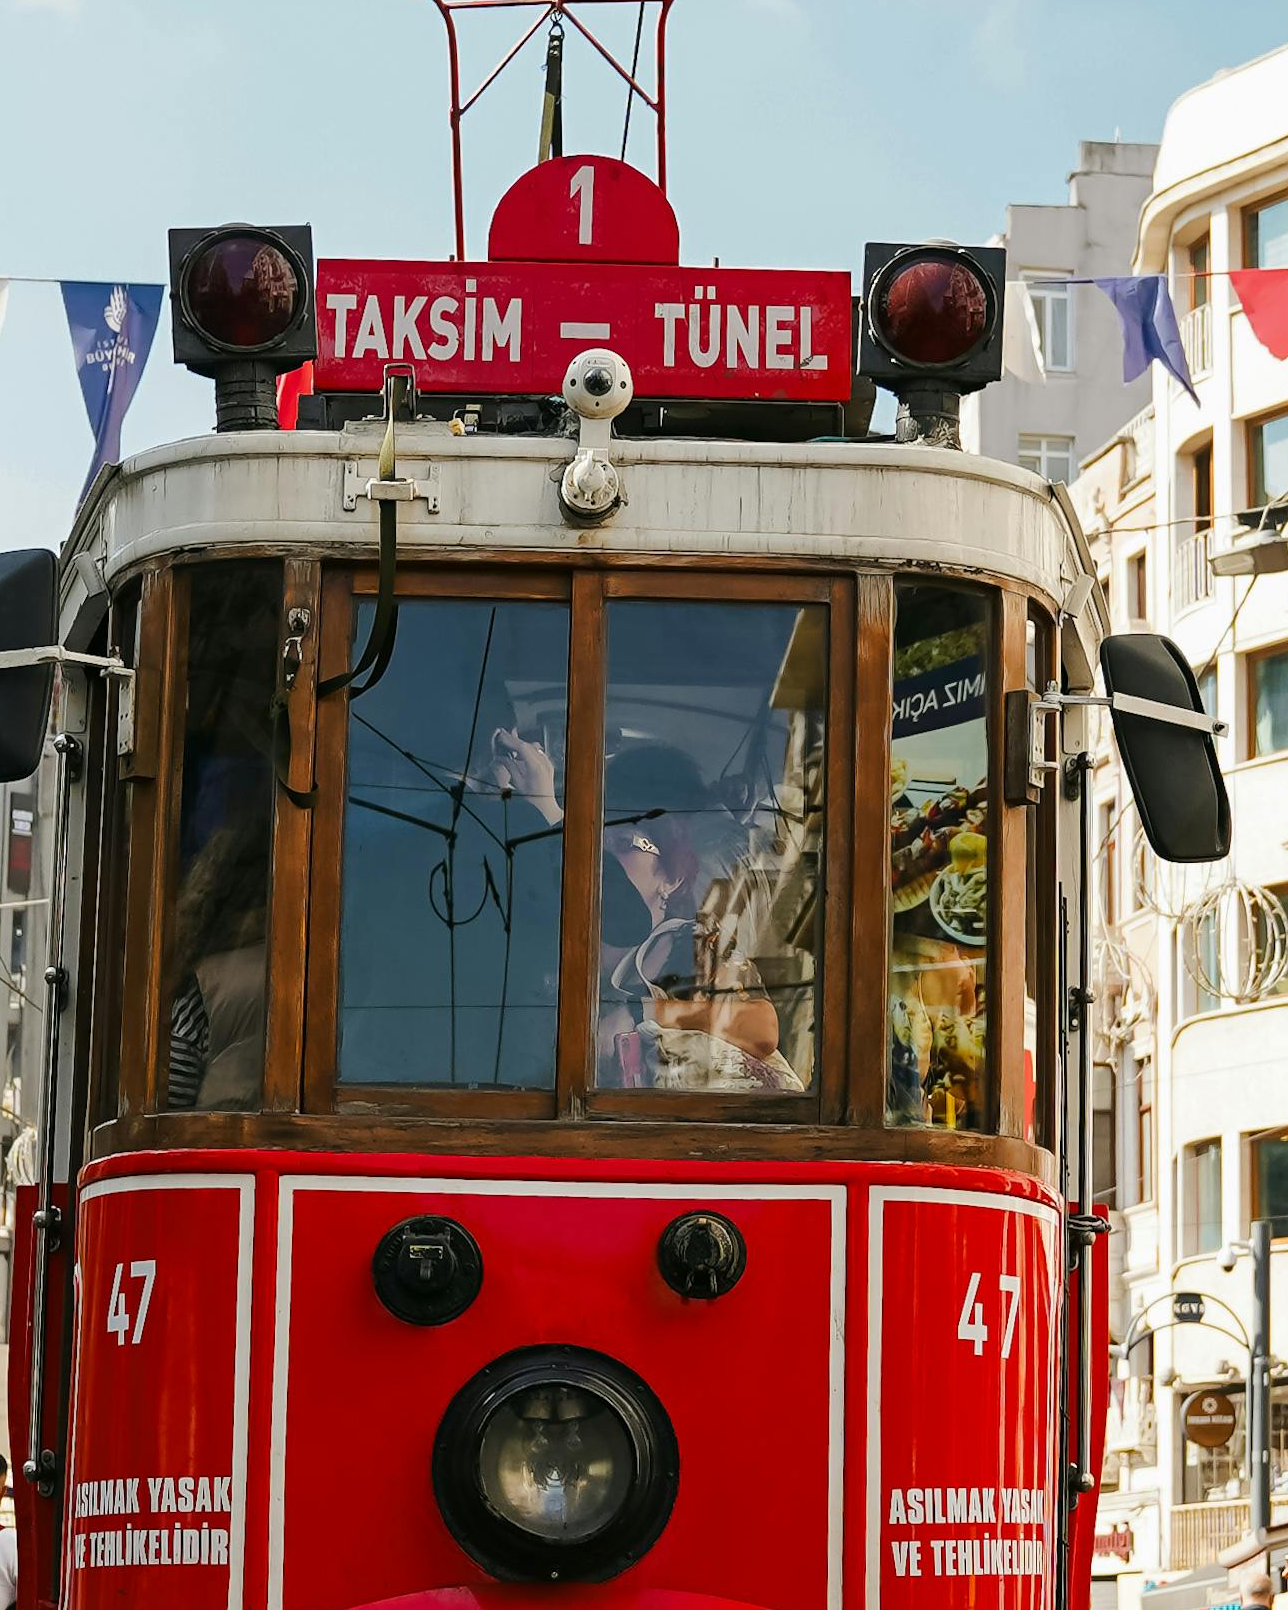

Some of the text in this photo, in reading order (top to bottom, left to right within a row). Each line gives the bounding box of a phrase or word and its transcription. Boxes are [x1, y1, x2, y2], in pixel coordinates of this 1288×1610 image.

[569, 165, 596, 245] 1
[326, 278, 523, 362] TAKSİM
[654, 285, 828, 370] TÜNEL
[107, 1259, 157, 1346] 47
[957, 1272, 1021, 1359] 47
[75, 1476, 232, 1518] ASILMAK YASAK
[889, 1488, 1044, 1525] ASILMAK YASAK
[74, 1521, 229, 1569] VE TEHLİKELİDİR
[891, 1532, 1044, 1577] VE TEHLİKELİDİR
